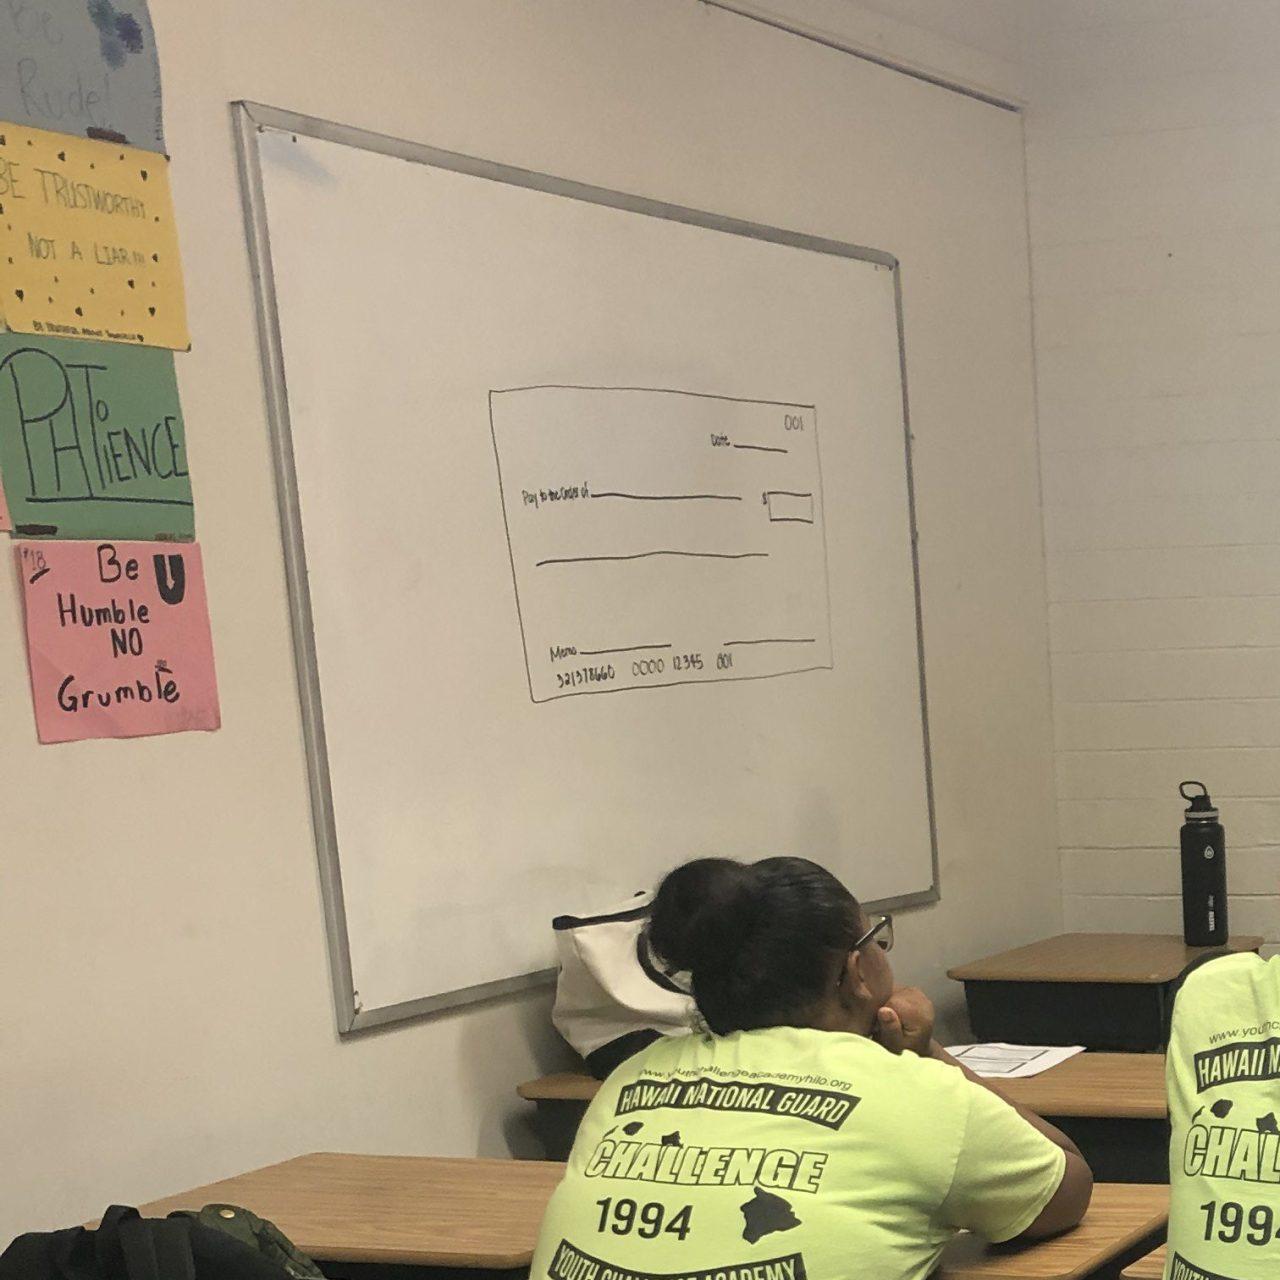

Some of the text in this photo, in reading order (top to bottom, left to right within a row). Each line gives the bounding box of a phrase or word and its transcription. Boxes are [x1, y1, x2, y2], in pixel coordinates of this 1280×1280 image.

[0, 157, 26, 199] BE
[27, 231, 57, 260] NOT
[71, 240, 83, 261] A
[521, 489, 540, 509] Pay
[97, 543, 140, 583] Be
[57, 593, 150, 627] Humble
[110, 627, 143, 658] NO
[550, 645, 578, 663] Memo
[57, 670, 181, 712] Grumble
[1198, 1048, 1266, 1088] HAWAII
[620, 1083, 851, 1123] HAWAII NATIONAL GUARD
[584, 1138, 829, 1194] CHALLENGE
[595, 1196, 694, 1241] 1994
